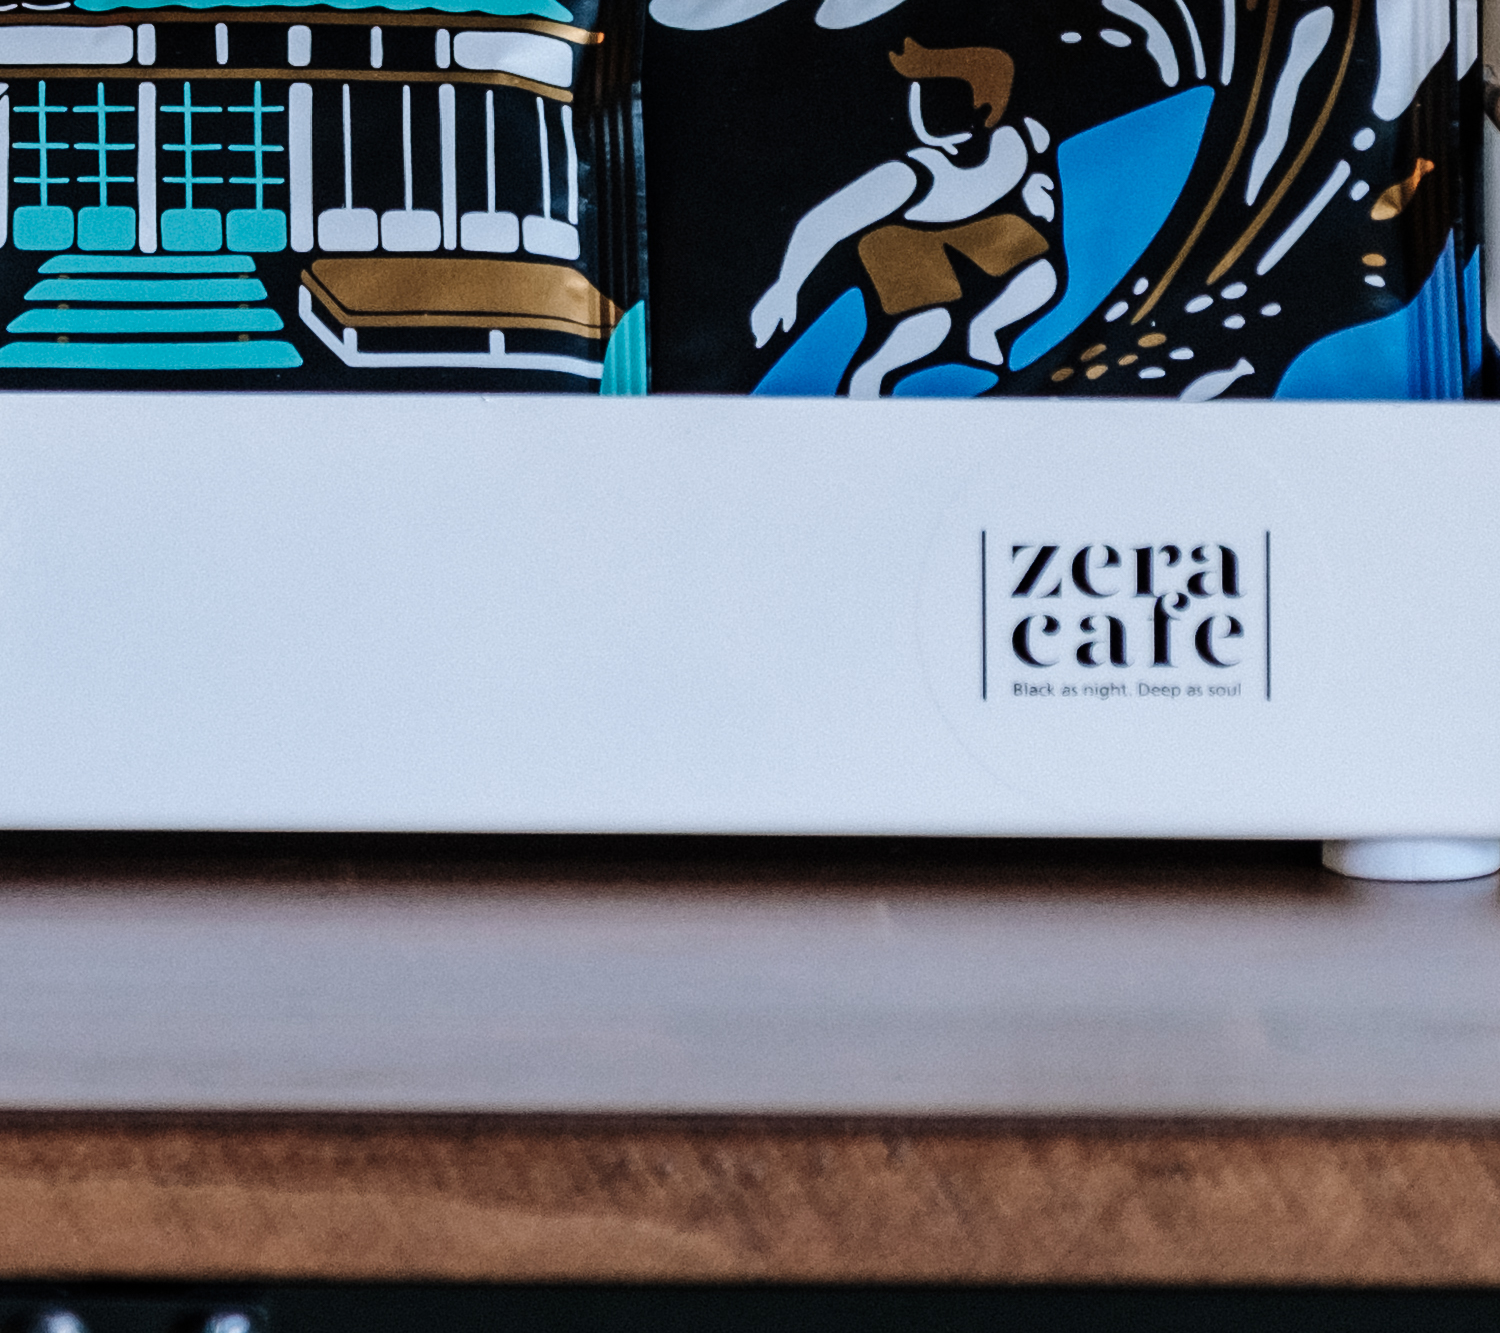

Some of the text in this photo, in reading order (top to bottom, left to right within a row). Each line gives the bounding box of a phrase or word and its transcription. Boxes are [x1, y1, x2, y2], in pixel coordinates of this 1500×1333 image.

[1010, 544, 1247, 599] zera
[1011, 591, 1245, 668] cafe
[1013, 682, 1055, 697] Black
[1062, 687, 1079, 697] as
[1138, 683, 1181, 700] Deep
[1187, 687, 1203, 697] as
[1208, 683, 1242, 697] soul
